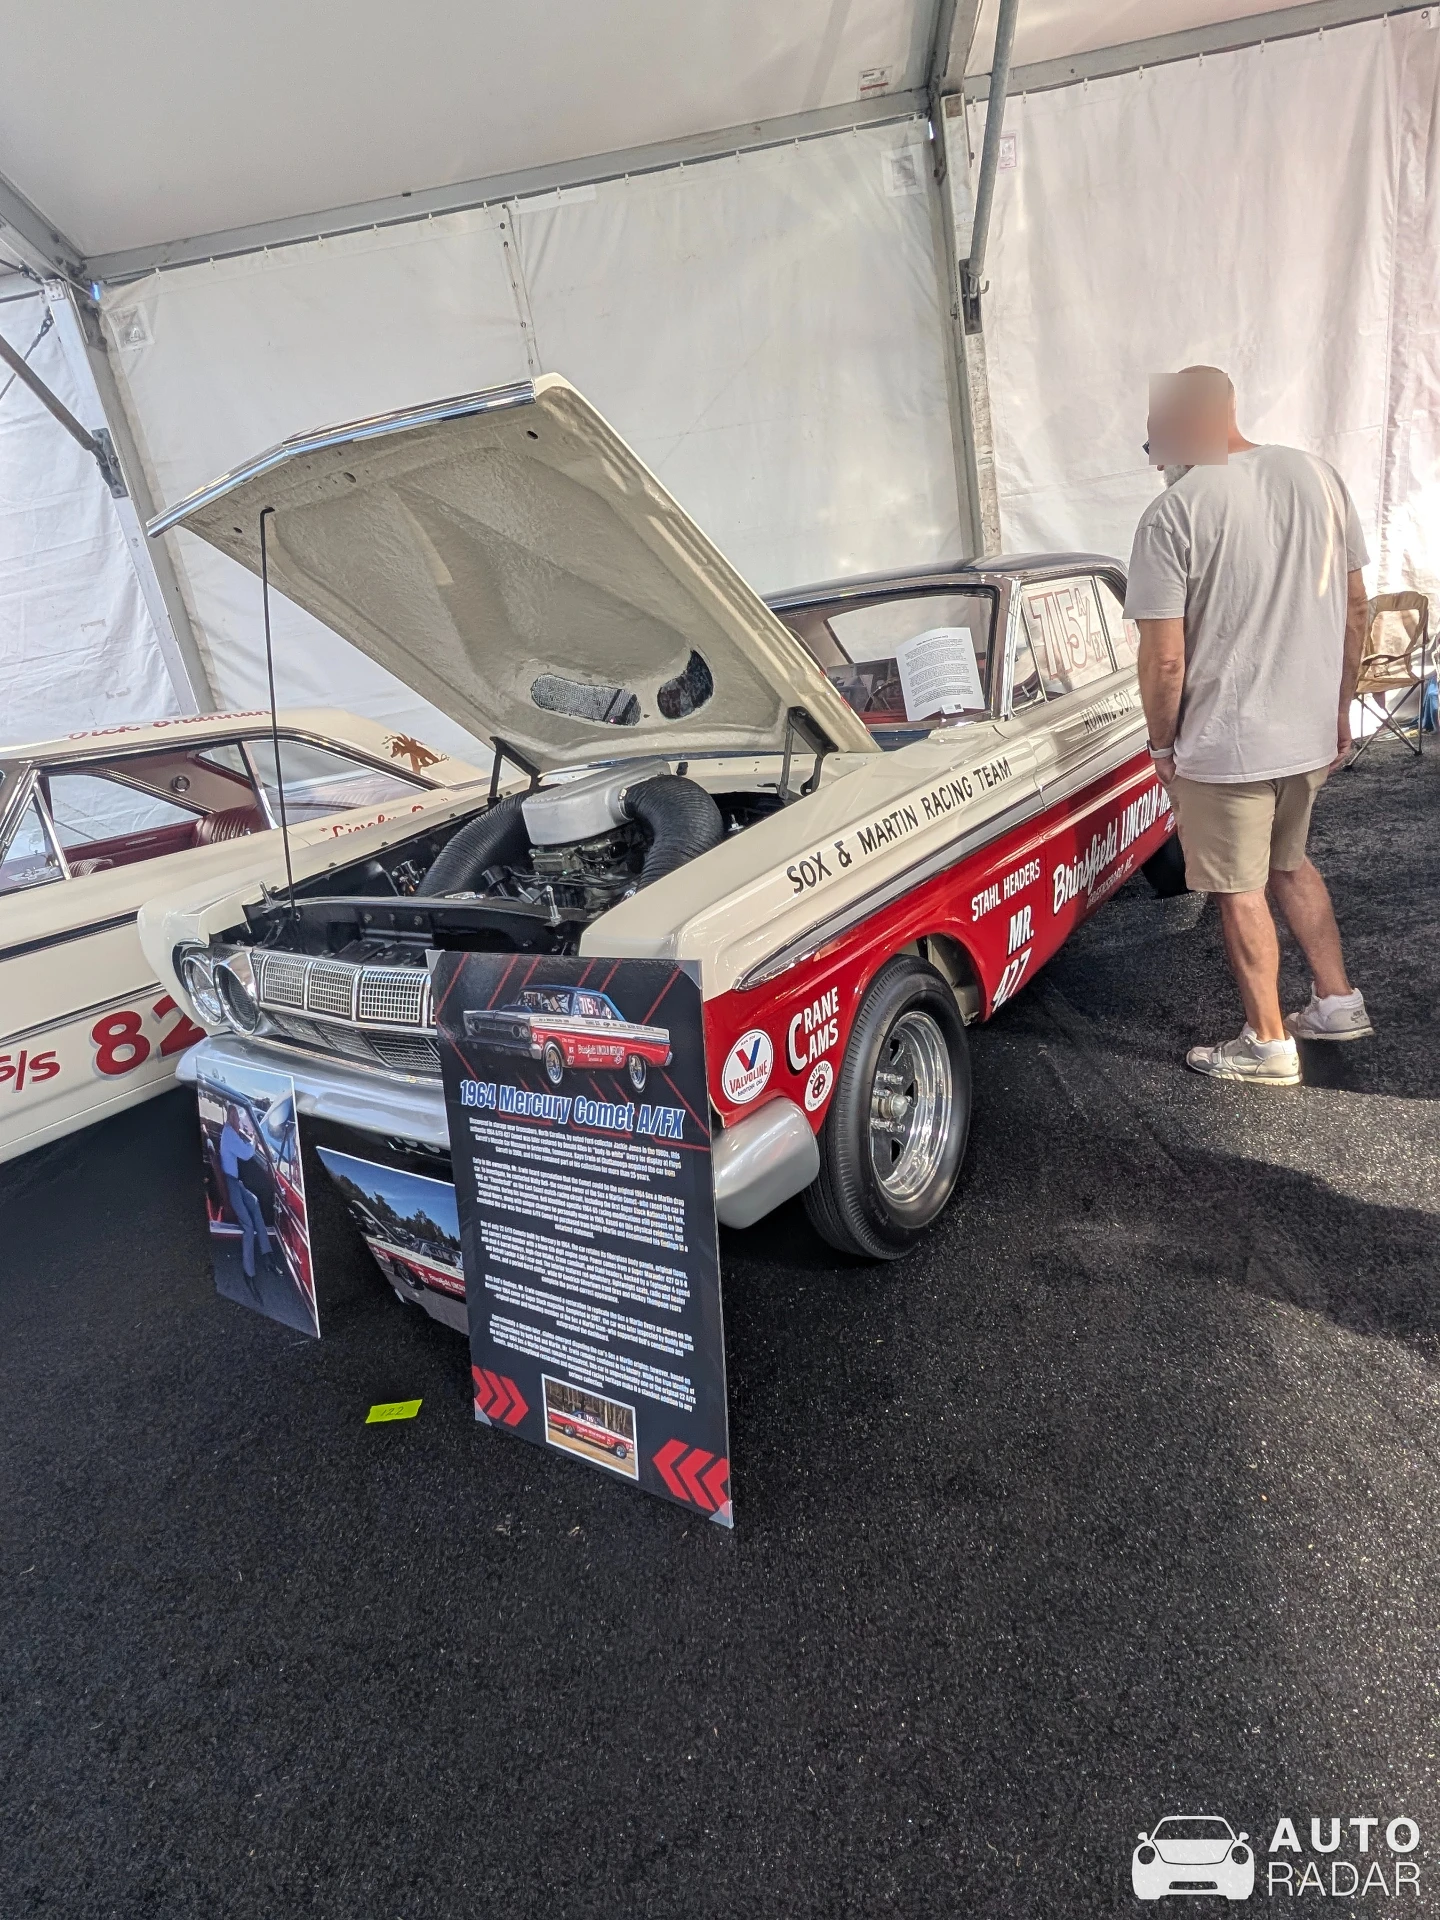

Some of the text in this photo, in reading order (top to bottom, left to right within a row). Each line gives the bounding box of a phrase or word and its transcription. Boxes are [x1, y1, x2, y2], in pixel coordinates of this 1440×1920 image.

[1028, 589, 1087, 680] 715
[1114, 689, 1135, 716] SOX
[786, 757, 1013, 894] SOX & MARTIN RACING TEAM
[971, 858, 1041, 922] STAHL HEADERS
[1053, 817, 1118, 914] Brinsfield
[1007, 905, 1034, 956] MR.
[991, 947, 1032, 1013] 427
[729, 1059, 768, 1094] VALVOLINE
[460, 1080, 686, 1139] 1964 Mercury Comet A/FX
[381, 1406, 404, 1417] 122
